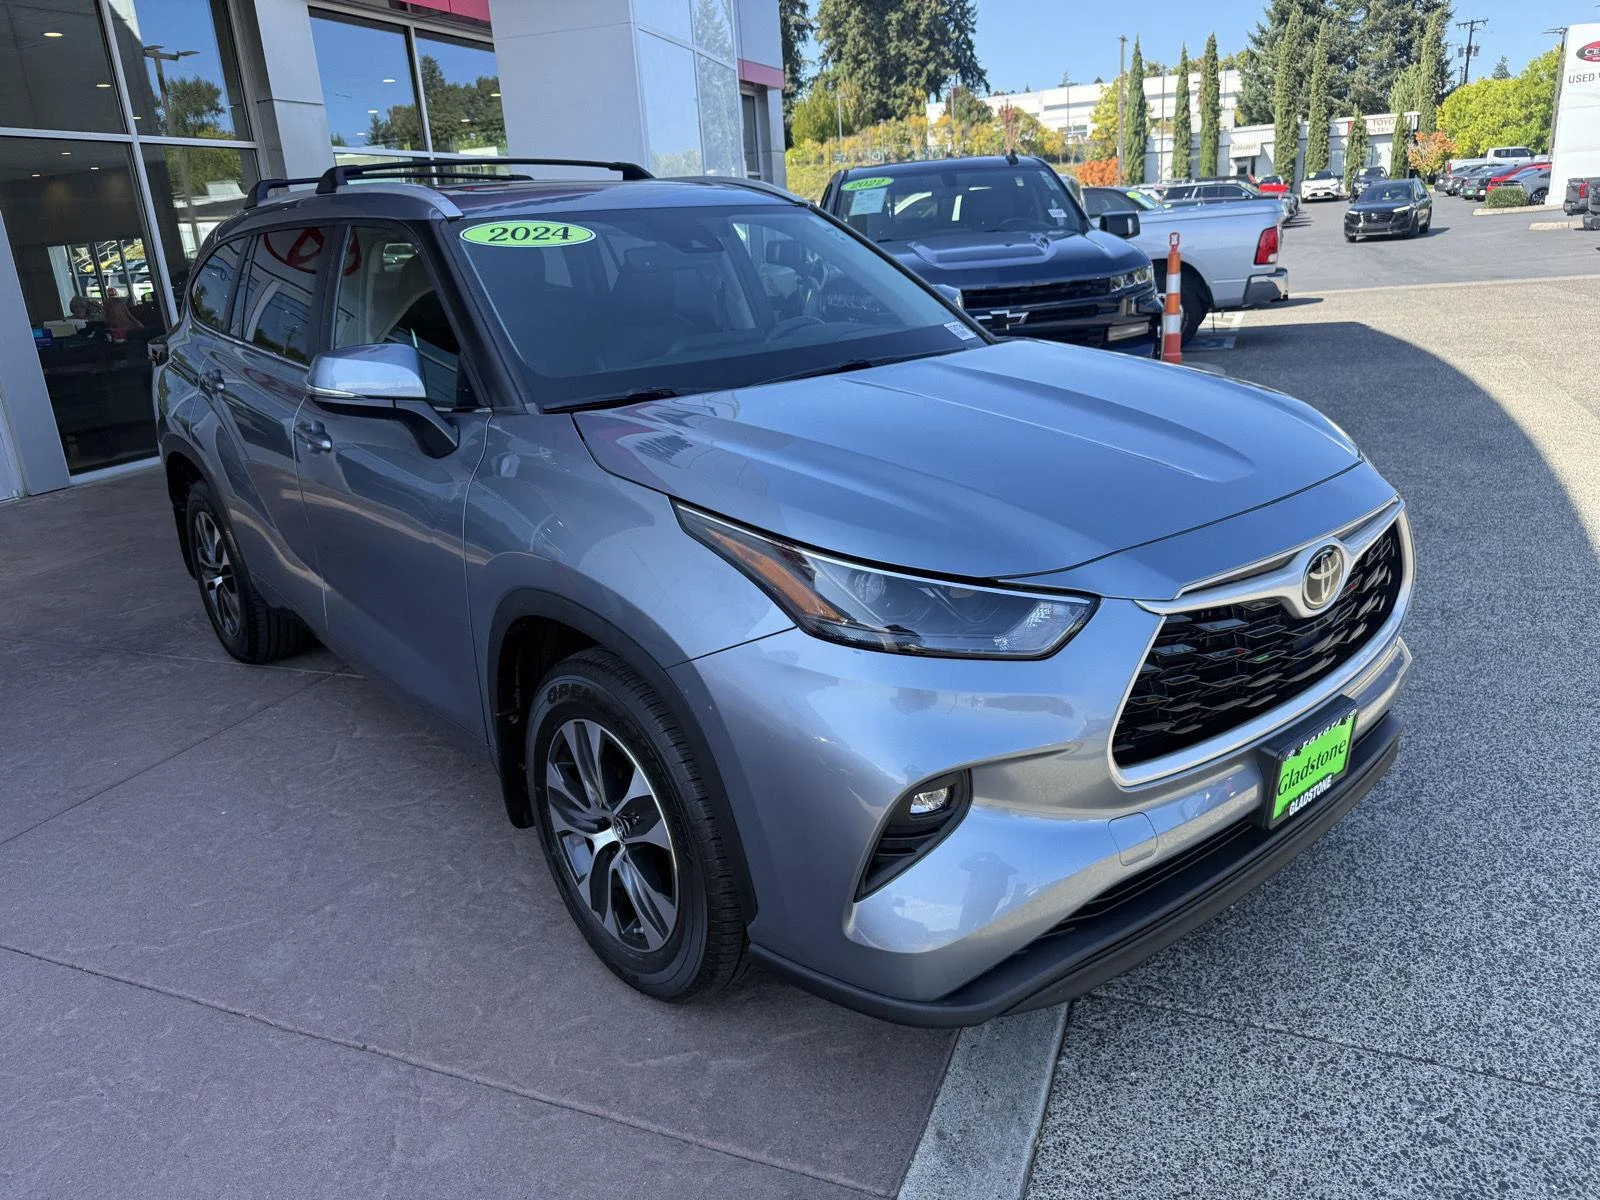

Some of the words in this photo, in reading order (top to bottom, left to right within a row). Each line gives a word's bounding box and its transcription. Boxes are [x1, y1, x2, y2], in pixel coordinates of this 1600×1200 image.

[1568, 73, 1595, 84] USED
[488, 226, 572, 242] 2024
[1278, 739, 1347, 796] Gladstone
[1289, 774, 1333, 816] GLADSTONE
